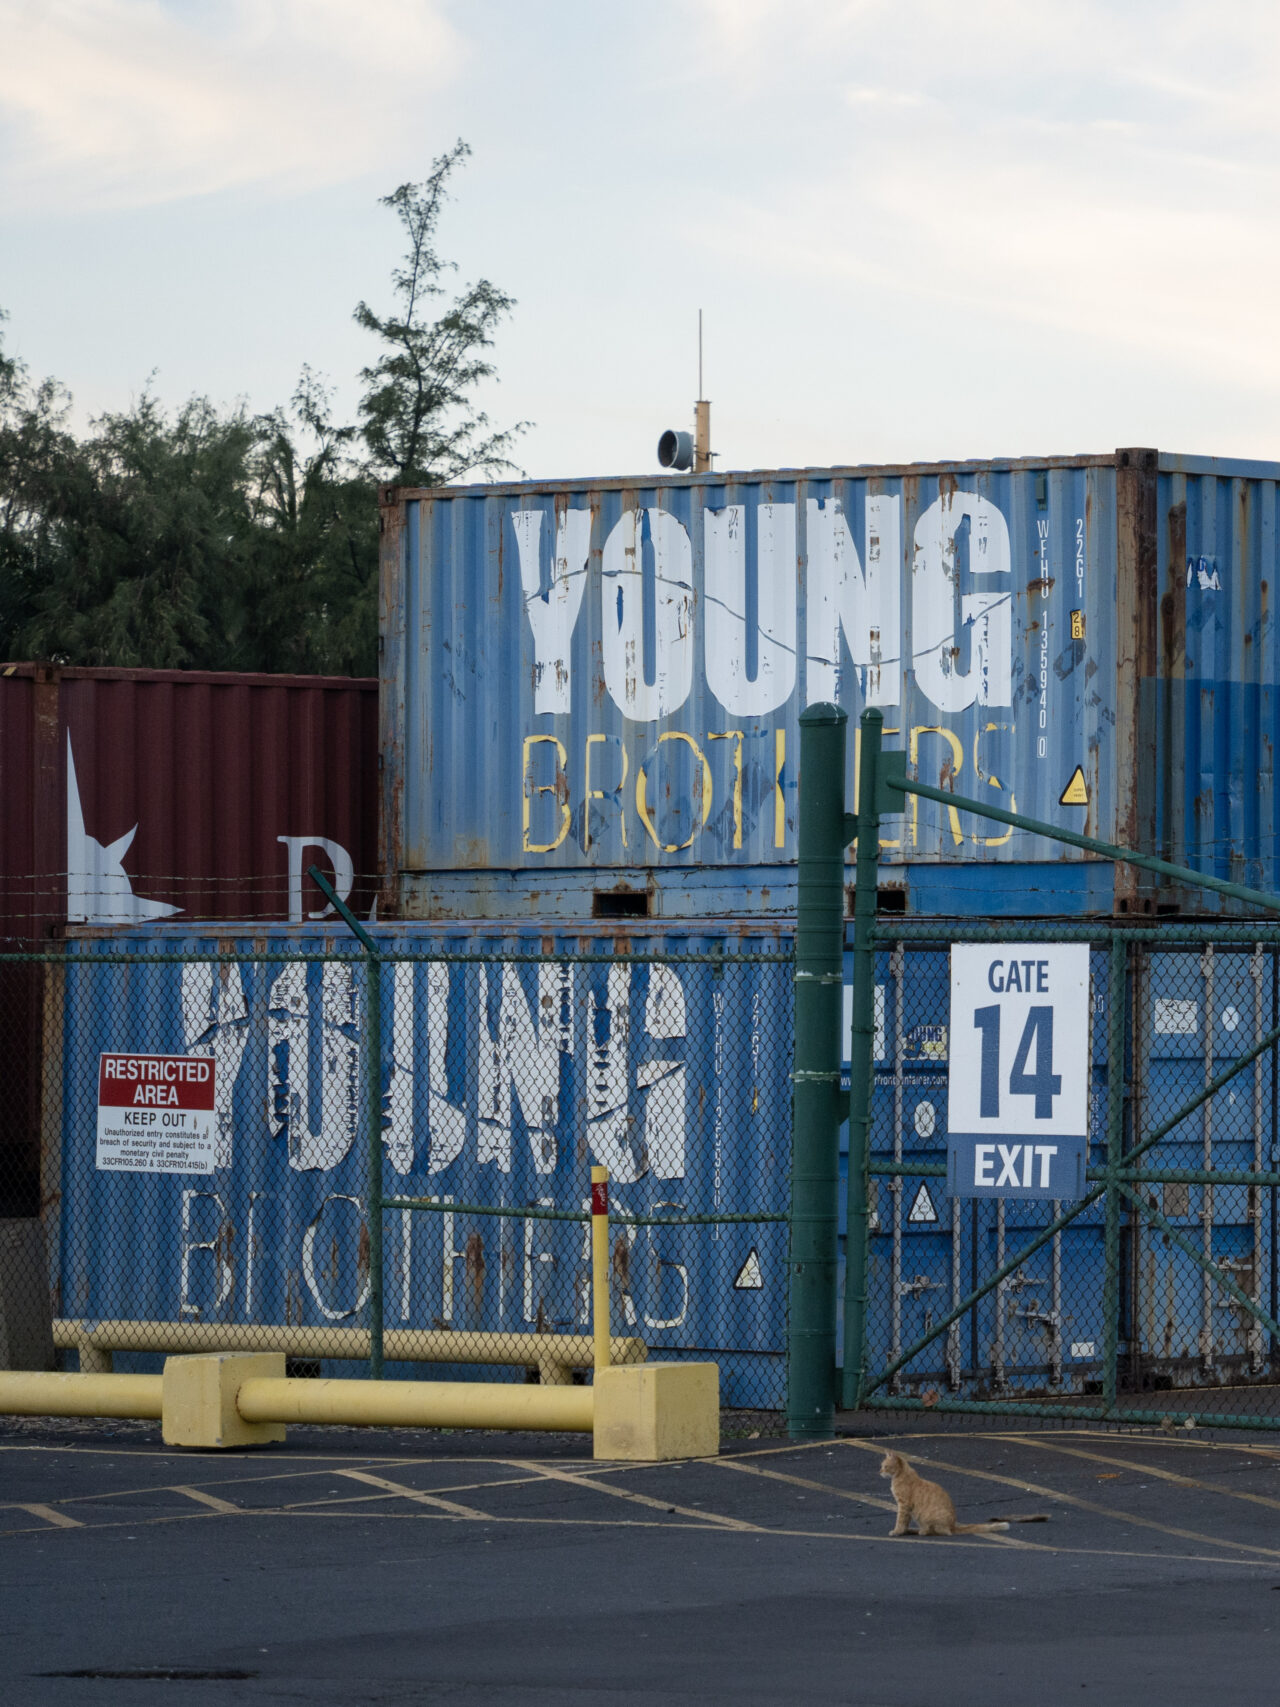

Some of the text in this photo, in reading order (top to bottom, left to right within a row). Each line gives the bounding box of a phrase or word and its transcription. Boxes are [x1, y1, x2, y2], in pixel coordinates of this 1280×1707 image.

[1037, 520, 1050, 599] WFHU
[1075, 518, 1084, 598] 22G1
[511, 490, 1012, 722] YOUNG
[1039, 611, 1048, 729] 135940
[522, 721, 1017, 854] BROTRS
[988, 959, 1049, 994] GATE
[105, 1058, 210, 1083] RESTRICTED
[181, 962, 687, 1184] YOUNG
[973, 1003, 1062, 1120] 14
[124, 1111, 187, 1127] KEEP OUT
[133, 1084, 179, 1106] AREA
[100, 1138, 120, 1146] breach
[132, 1140, 156, 1148] security
[159, 1140, 170, 1148] and
[173, 1141, 196, 1150] subject
[104, 1128, 144, 1137] Unauthorized
[147, 1130, 162, 1138] entry
[166, 1130, 200, 1140] constitutes
[120, 1150, 190, 1160] monetary civil penalty
[974, 1143, 1058, 1188] EXIT
[180, 1189, 689, 1329] BOTHERS
